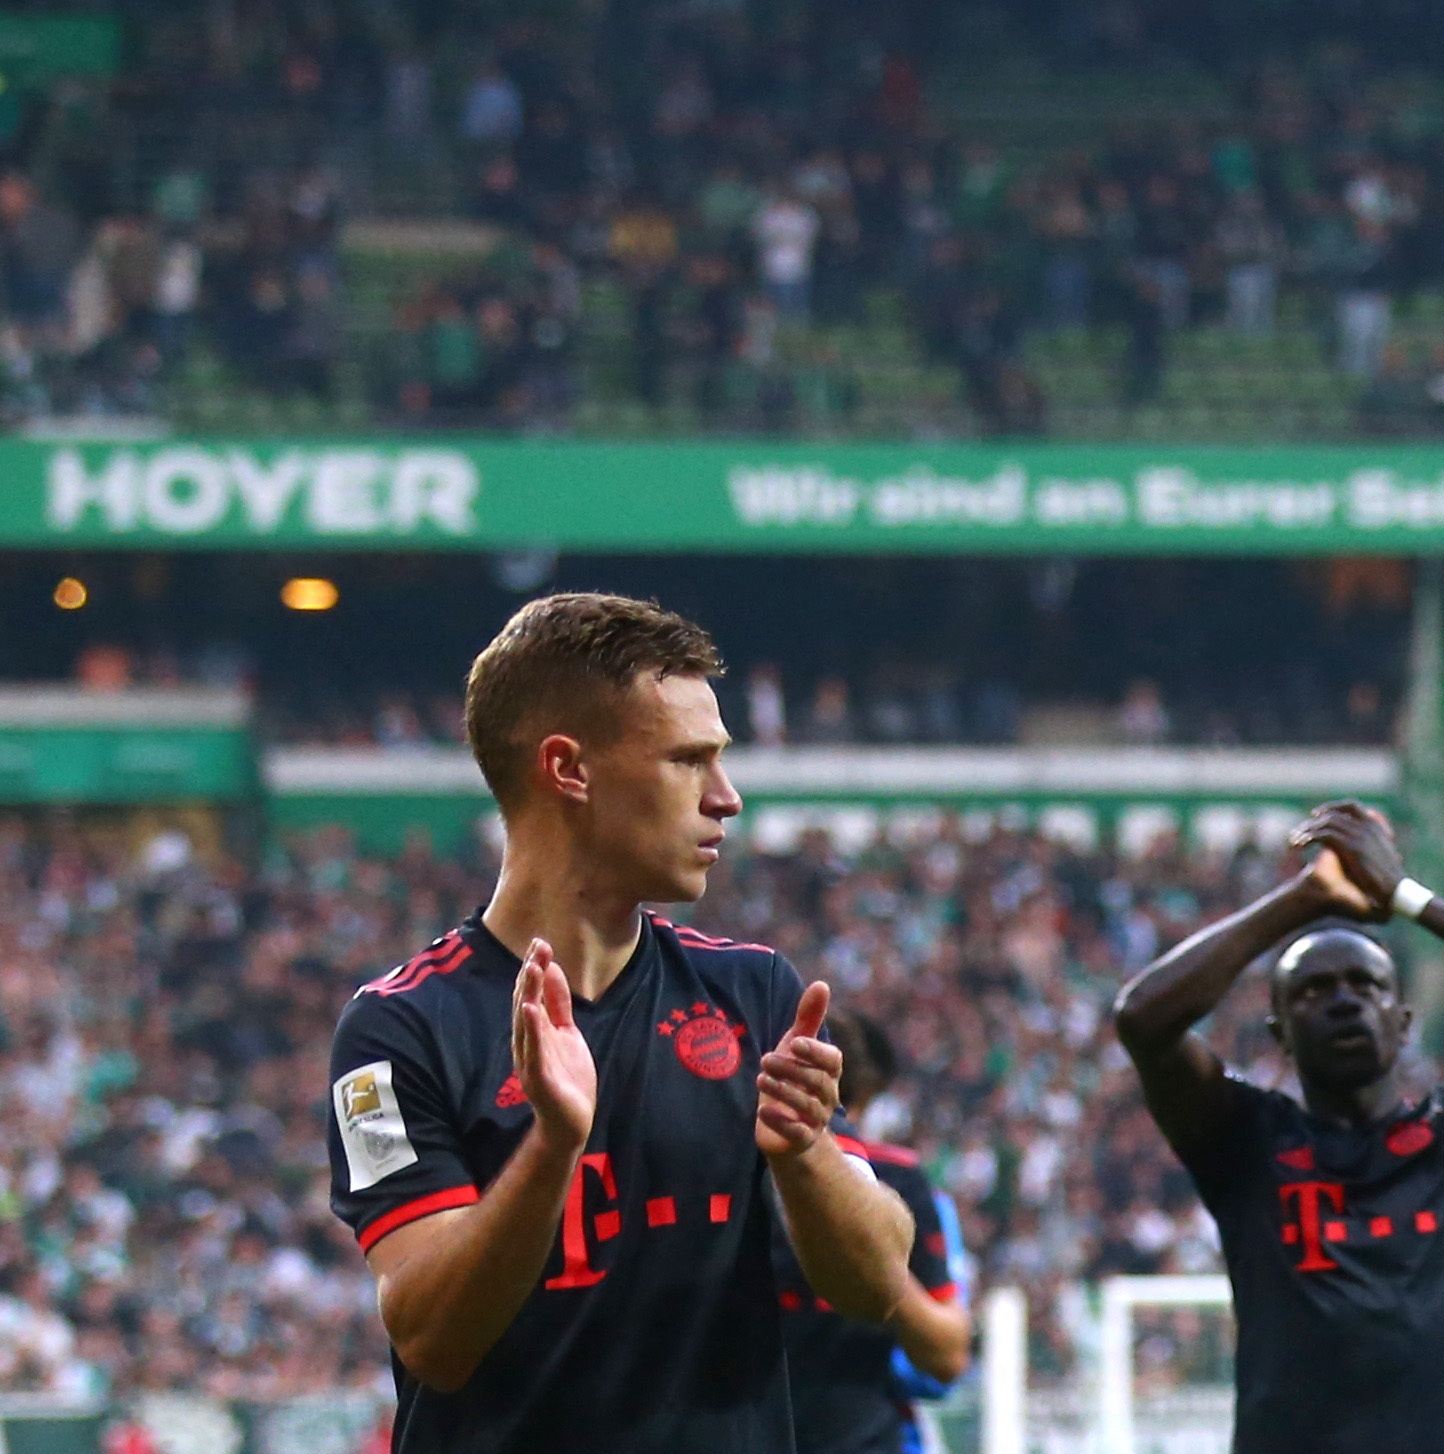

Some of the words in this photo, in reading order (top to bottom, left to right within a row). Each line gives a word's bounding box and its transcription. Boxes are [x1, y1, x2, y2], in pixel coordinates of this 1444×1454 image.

[46, 449, 480, 537] HOYER
[727, 464, 858, 527] Wir
[869, 464, 1027, 528] sind
[1034, 476, 1128, 529] an
[1134, 467, 1336, 530] Eurer
